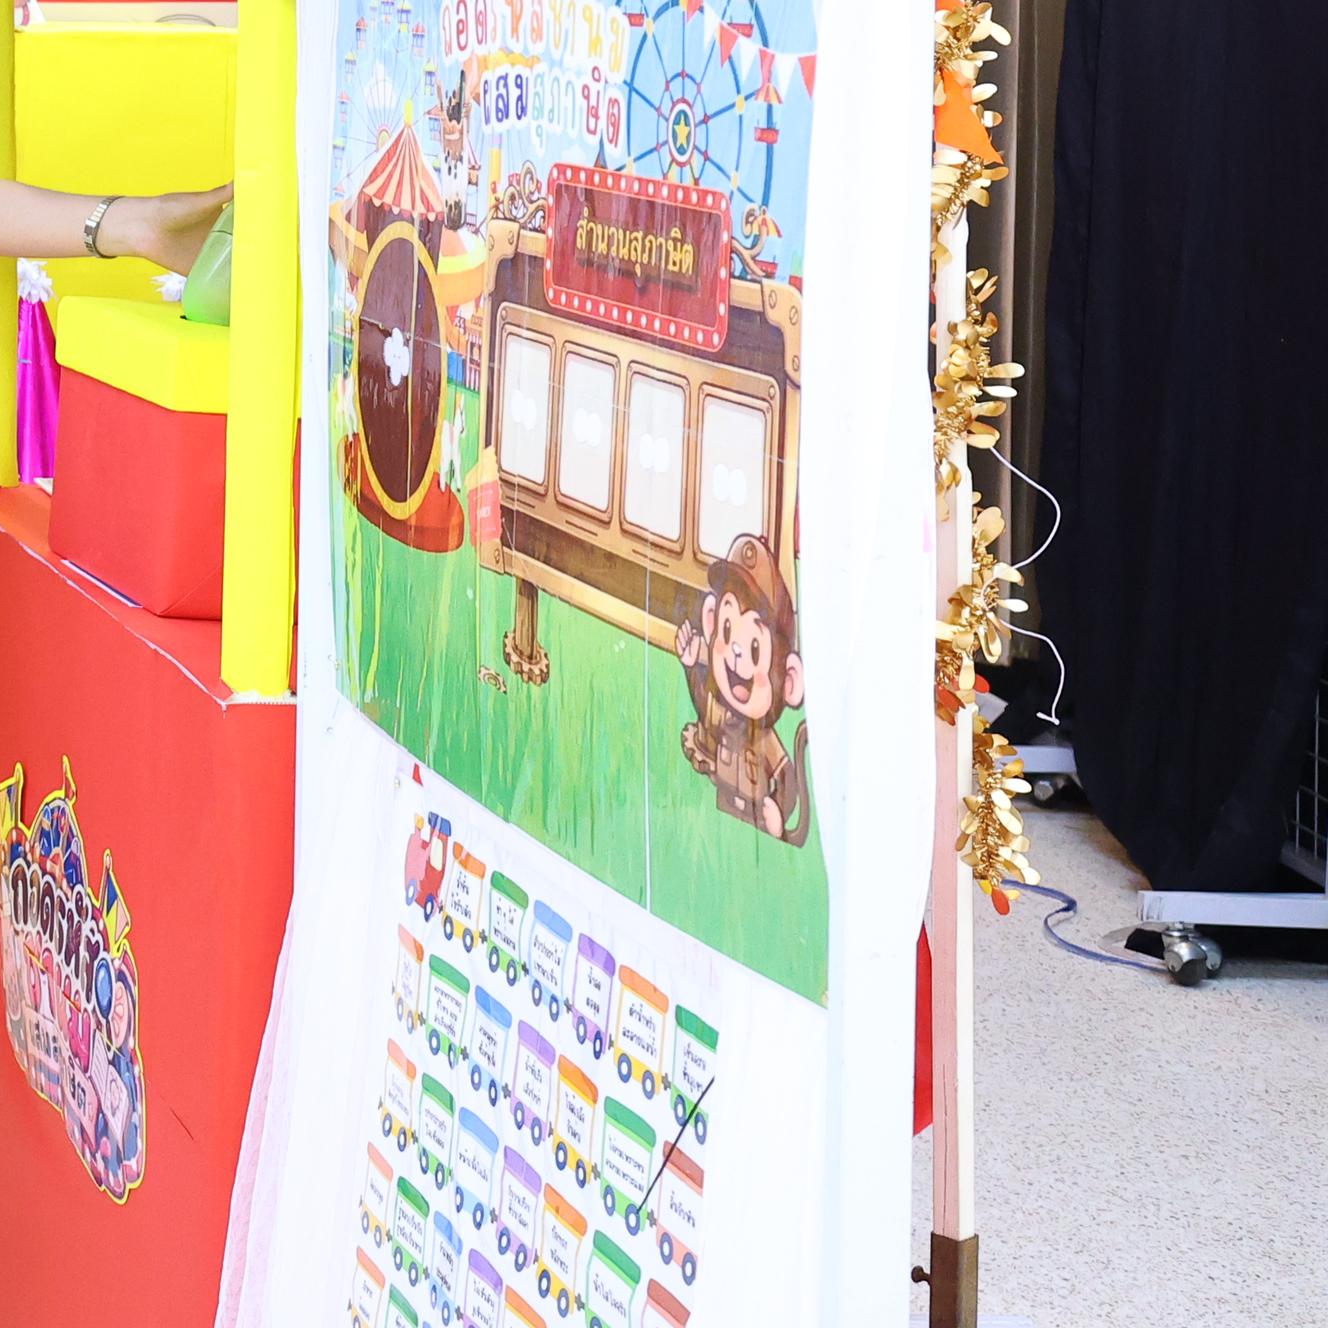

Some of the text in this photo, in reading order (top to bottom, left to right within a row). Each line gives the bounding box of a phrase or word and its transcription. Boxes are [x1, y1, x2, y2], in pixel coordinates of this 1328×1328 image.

[483, 65, 621, 149] ผสมสุภาษิต
[574, 206, 696, 277] สำนวนสุภาษิต
